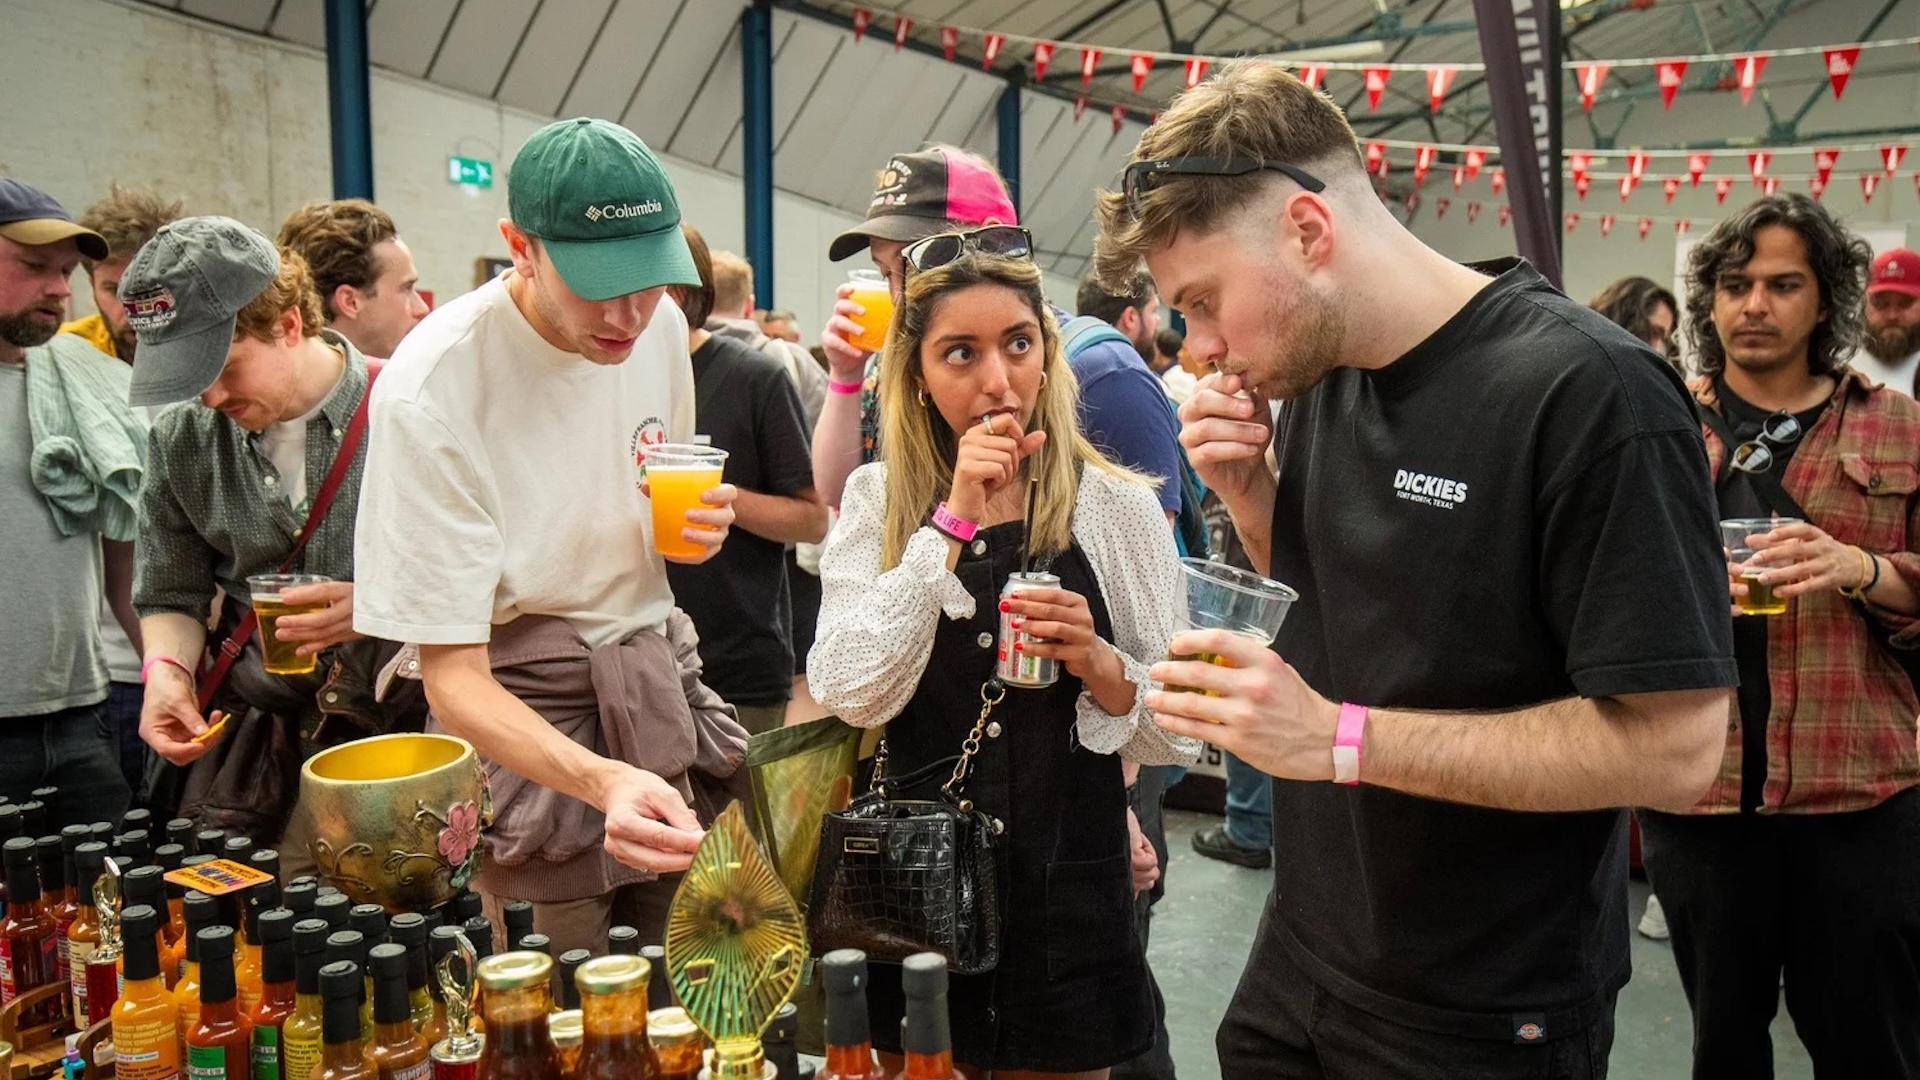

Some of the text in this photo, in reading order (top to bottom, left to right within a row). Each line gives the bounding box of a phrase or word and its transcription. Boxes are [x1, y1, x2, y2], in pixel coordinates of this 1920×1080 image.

[602, 199, 662, 219] Columbia
[1393, 469, 1468, 503] DICKIES
[1396, 490, 1411, 501] FORT
[1433, 499, 1454, 510] TEXAS
[937, 509, 962, 532] IS LIFE
